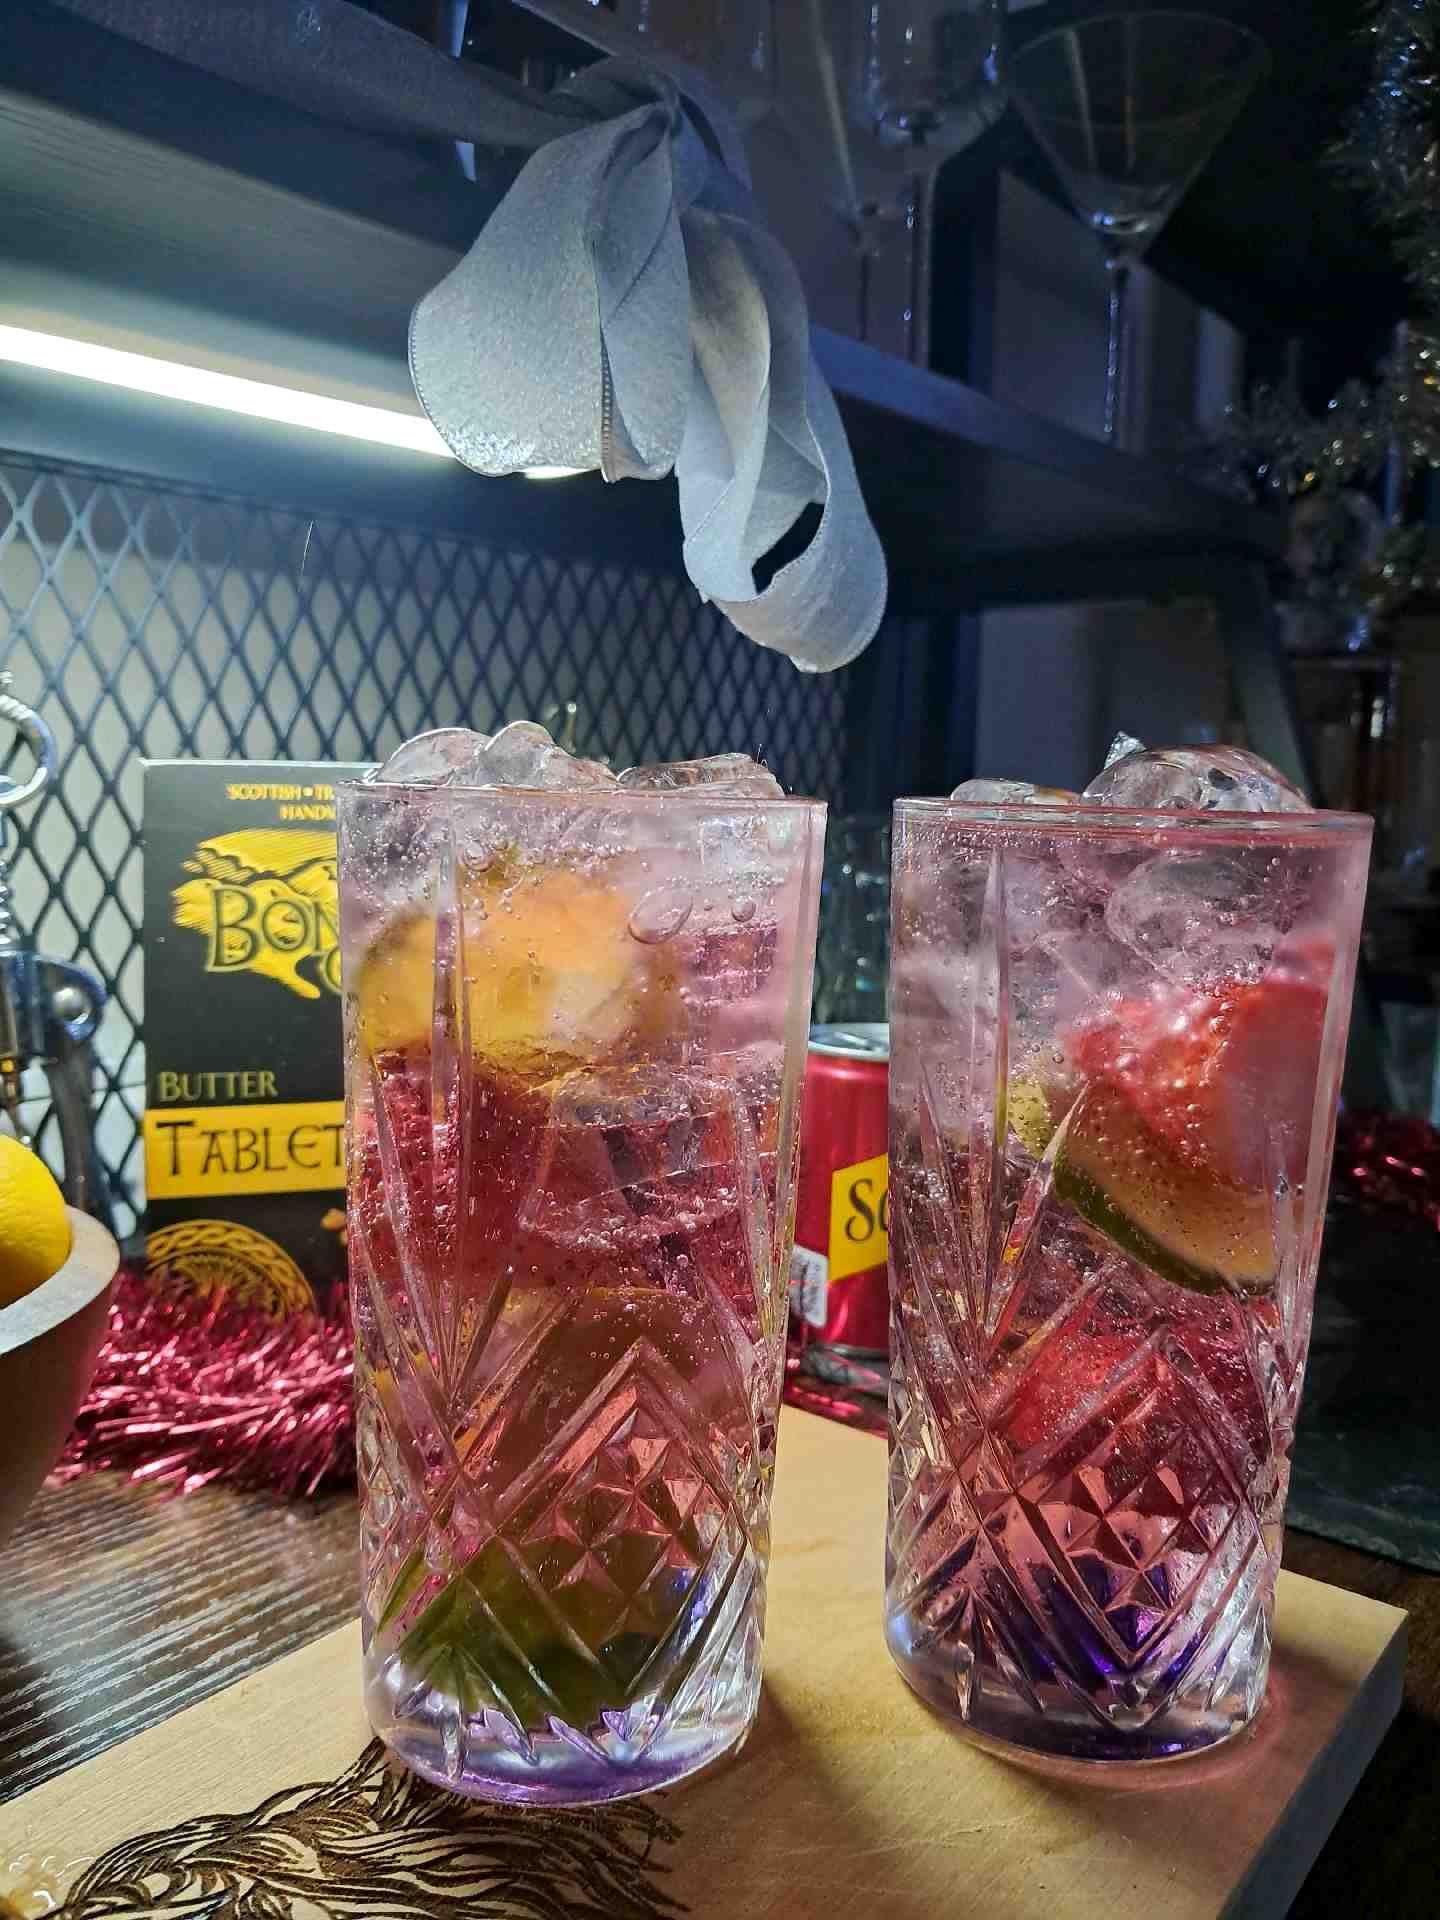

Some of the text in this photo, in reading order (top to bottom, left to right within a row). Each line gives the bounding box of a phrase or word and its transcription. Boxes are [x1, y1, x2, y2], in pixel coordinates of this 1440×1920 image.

[227, 784, 301, 800] SCOTTISH
[159, 1071, 277, 1100] BUTTER
[156, 1120, 344, 1176] TABLET
